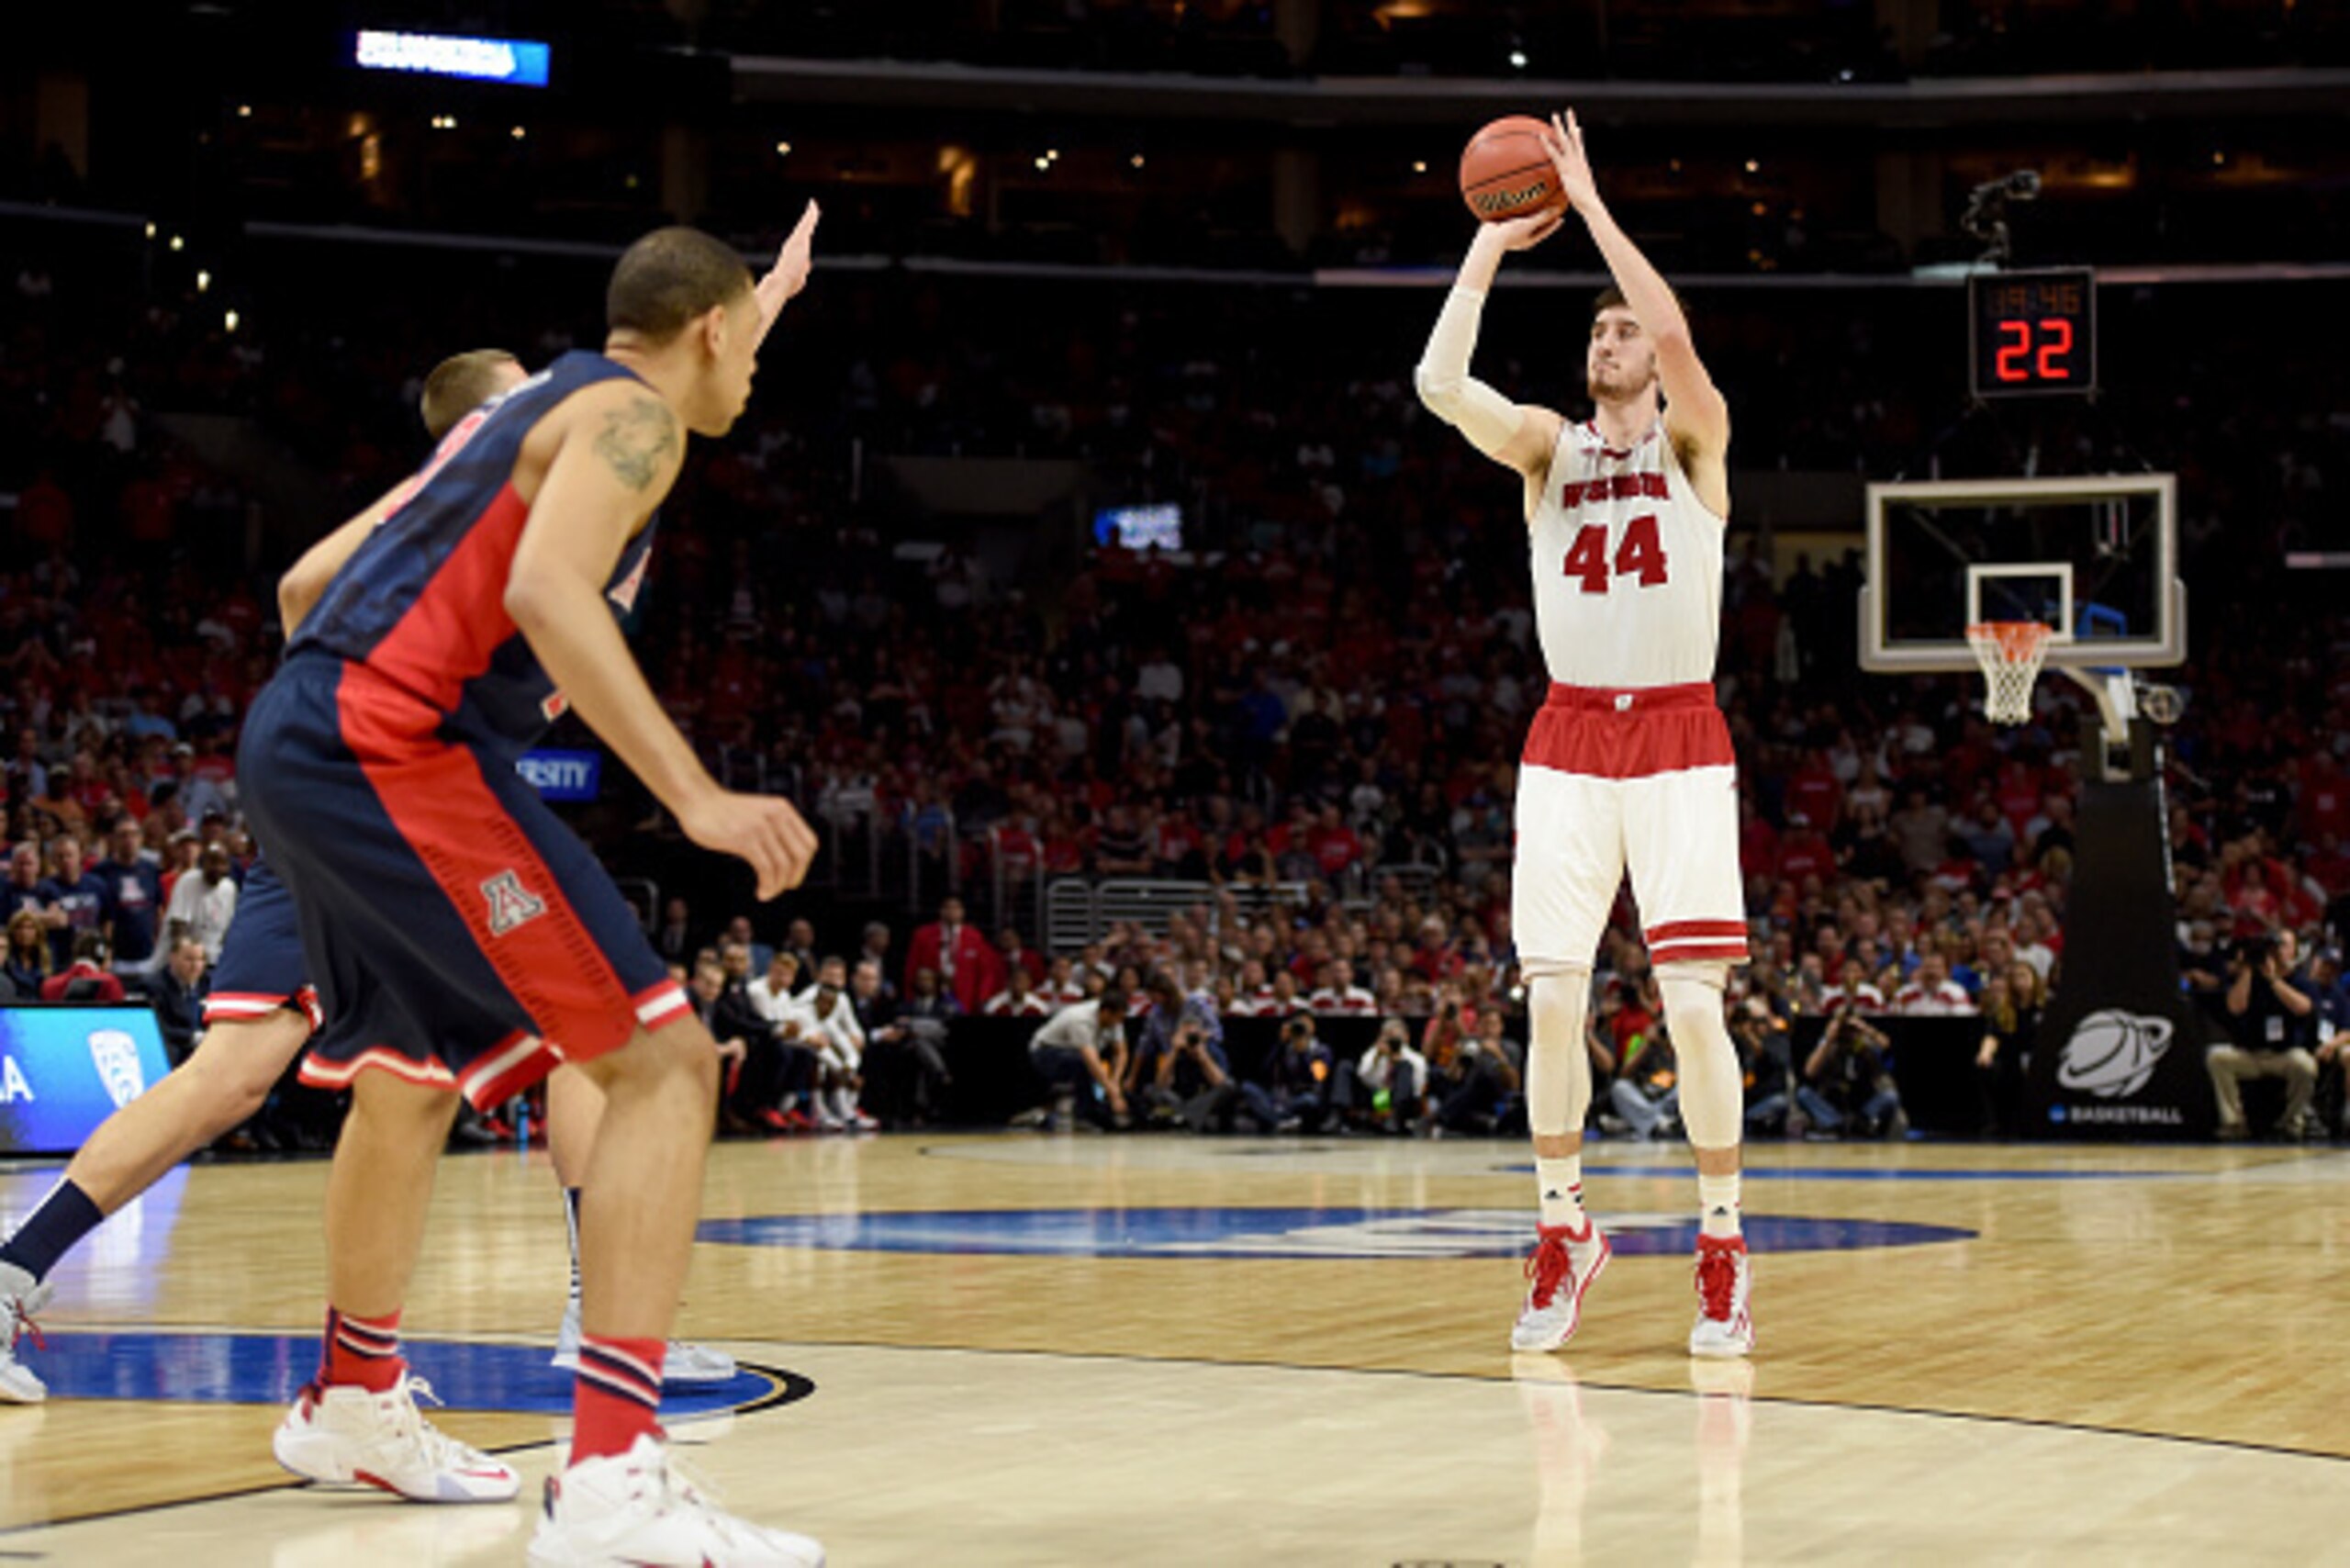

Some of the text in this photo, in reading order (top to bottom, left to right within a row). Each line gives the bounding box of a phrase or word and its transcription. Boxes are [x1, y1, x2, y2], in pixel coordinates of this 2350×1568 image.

[1996, 317, 2075, 383] 22
[1563, 514, 1669, 594] 44
[2069, 1103, 2185, 1126] BASKETBALL
